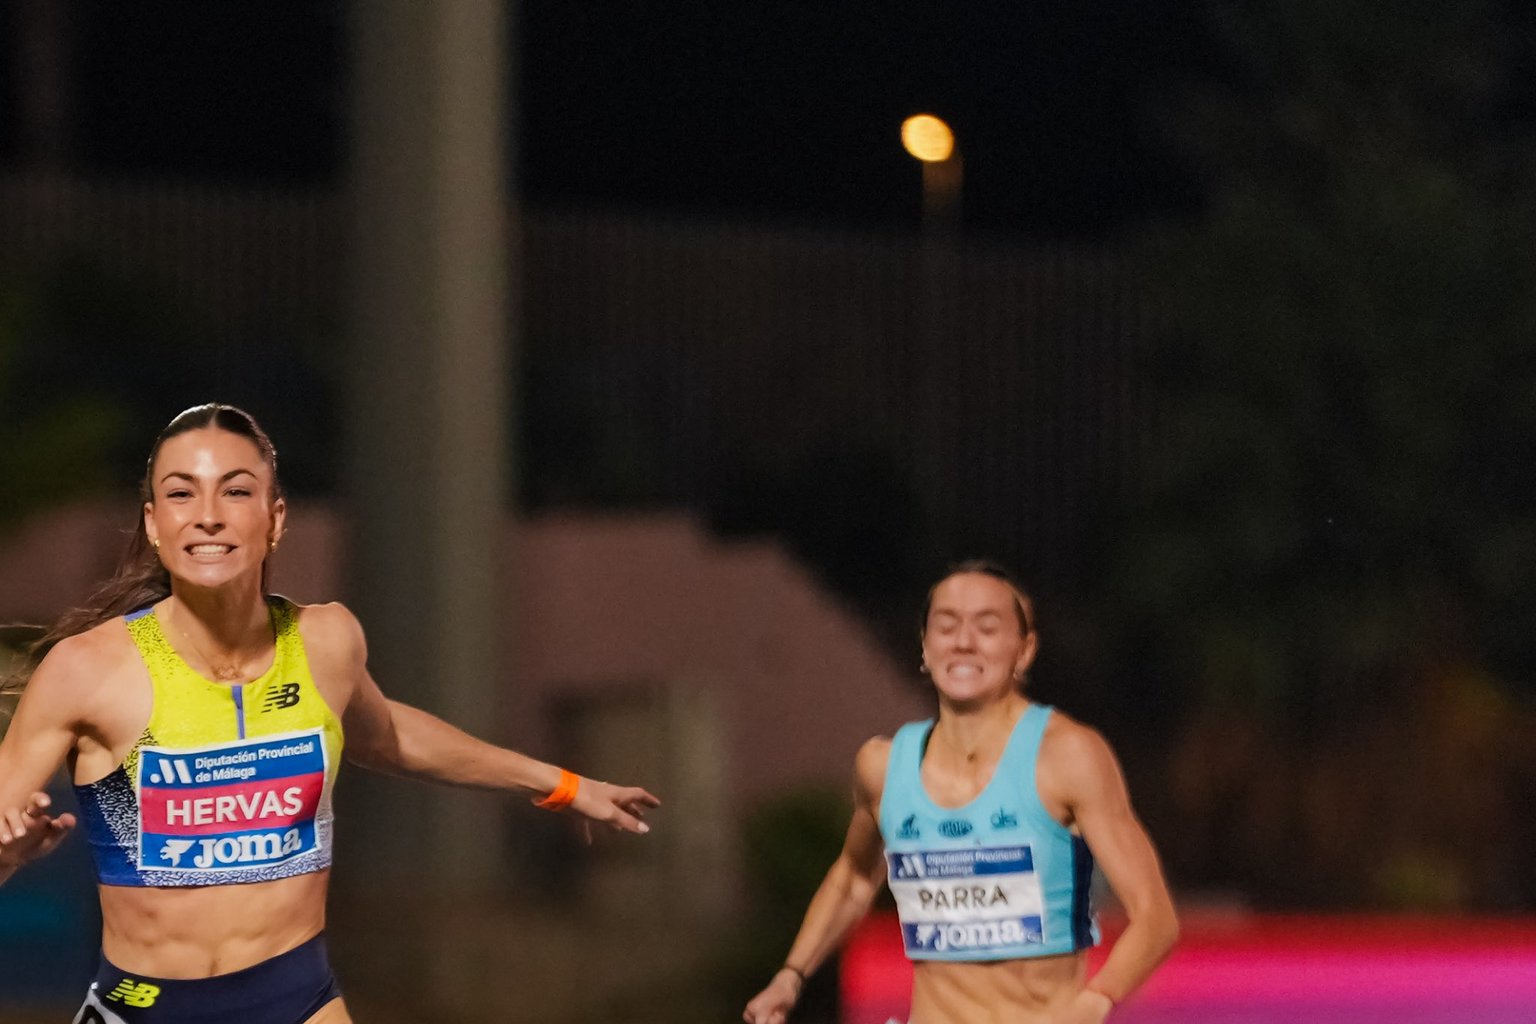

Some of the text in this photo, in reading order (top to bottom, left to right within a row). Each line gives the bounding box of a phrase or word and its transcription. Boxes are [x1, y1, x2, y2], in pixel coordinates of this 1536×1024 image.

[195, 741, 313, 770] Diputación Provincial
[195, 767, 256, 783] de Málaga
[166, 787, 303, 827] HERVAS
[918, 885, 1009, 911] PARRA
